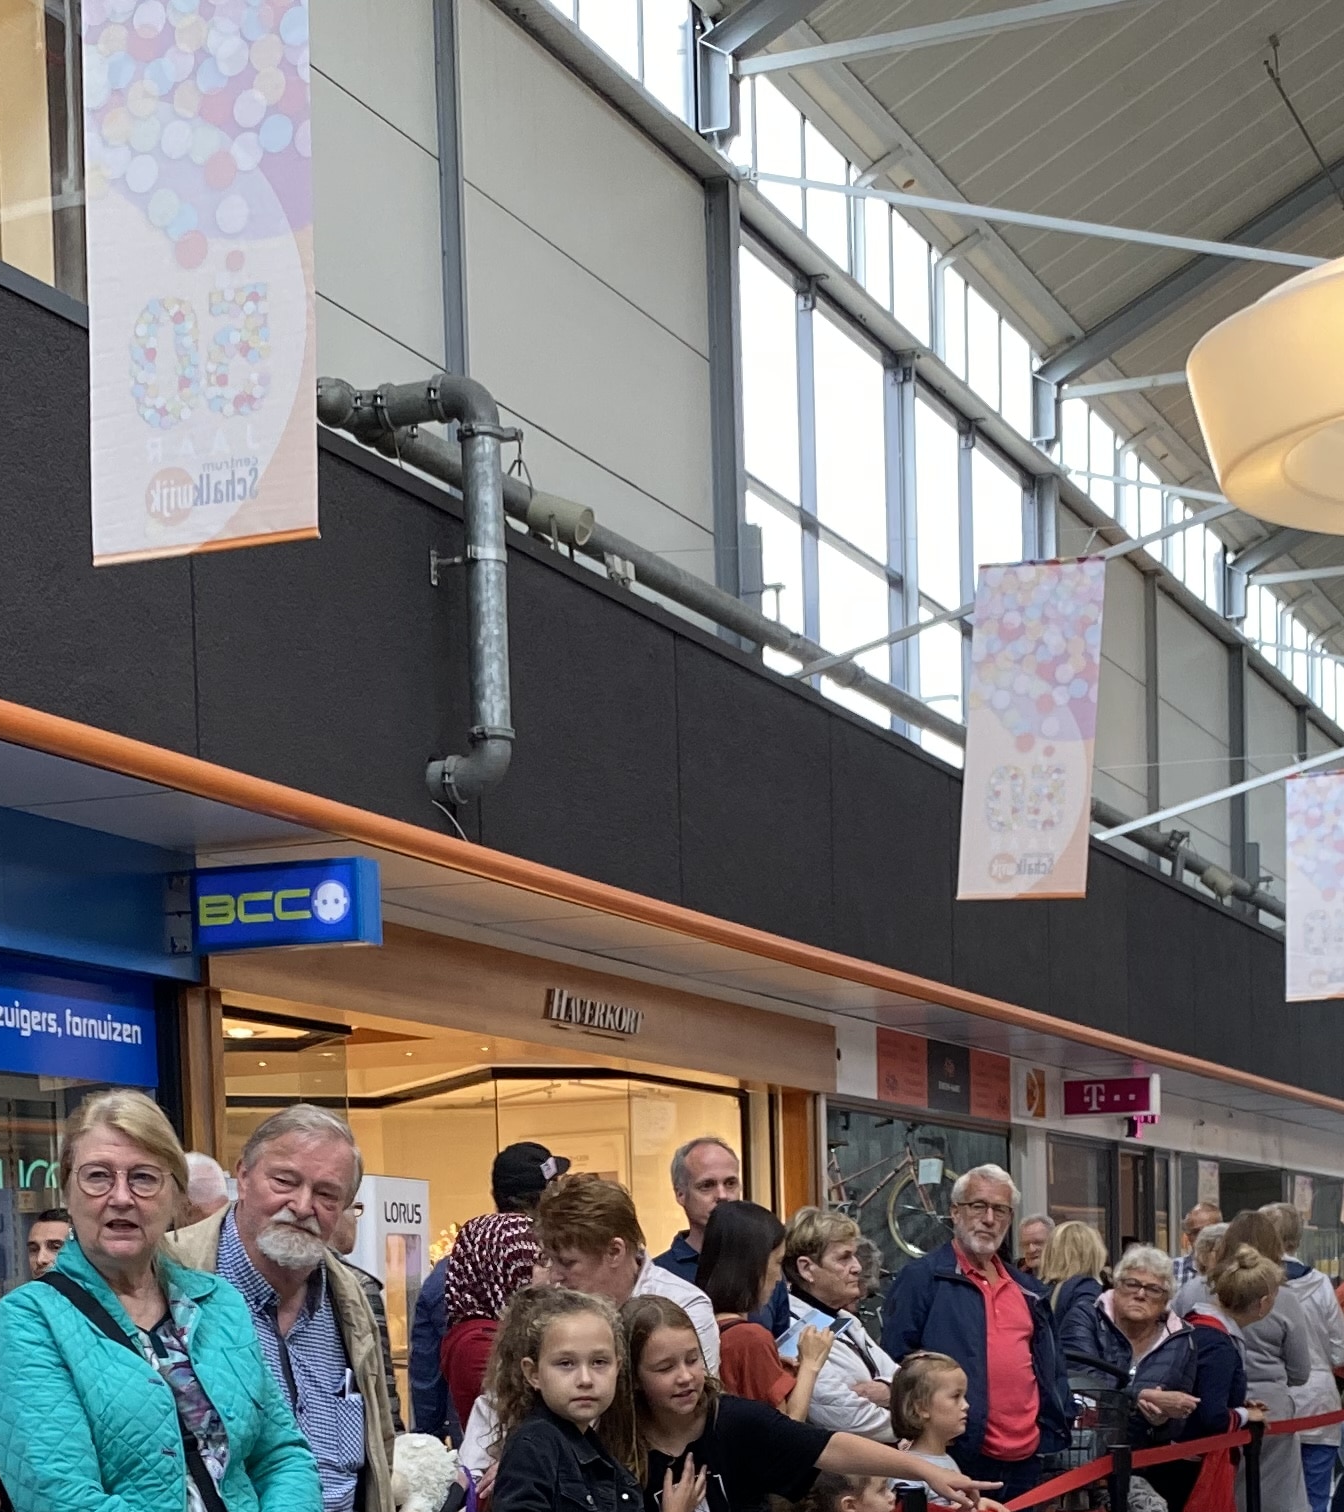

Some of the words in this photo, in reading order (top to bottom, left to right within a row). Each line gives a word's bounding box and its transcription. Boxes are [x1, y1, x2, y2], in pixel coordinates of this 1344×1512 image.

[199, 888, 312, 926] BCC
[65, 1009, 142, 1045] fornuizen
[384, 1201, 422, 1224] LORUS
